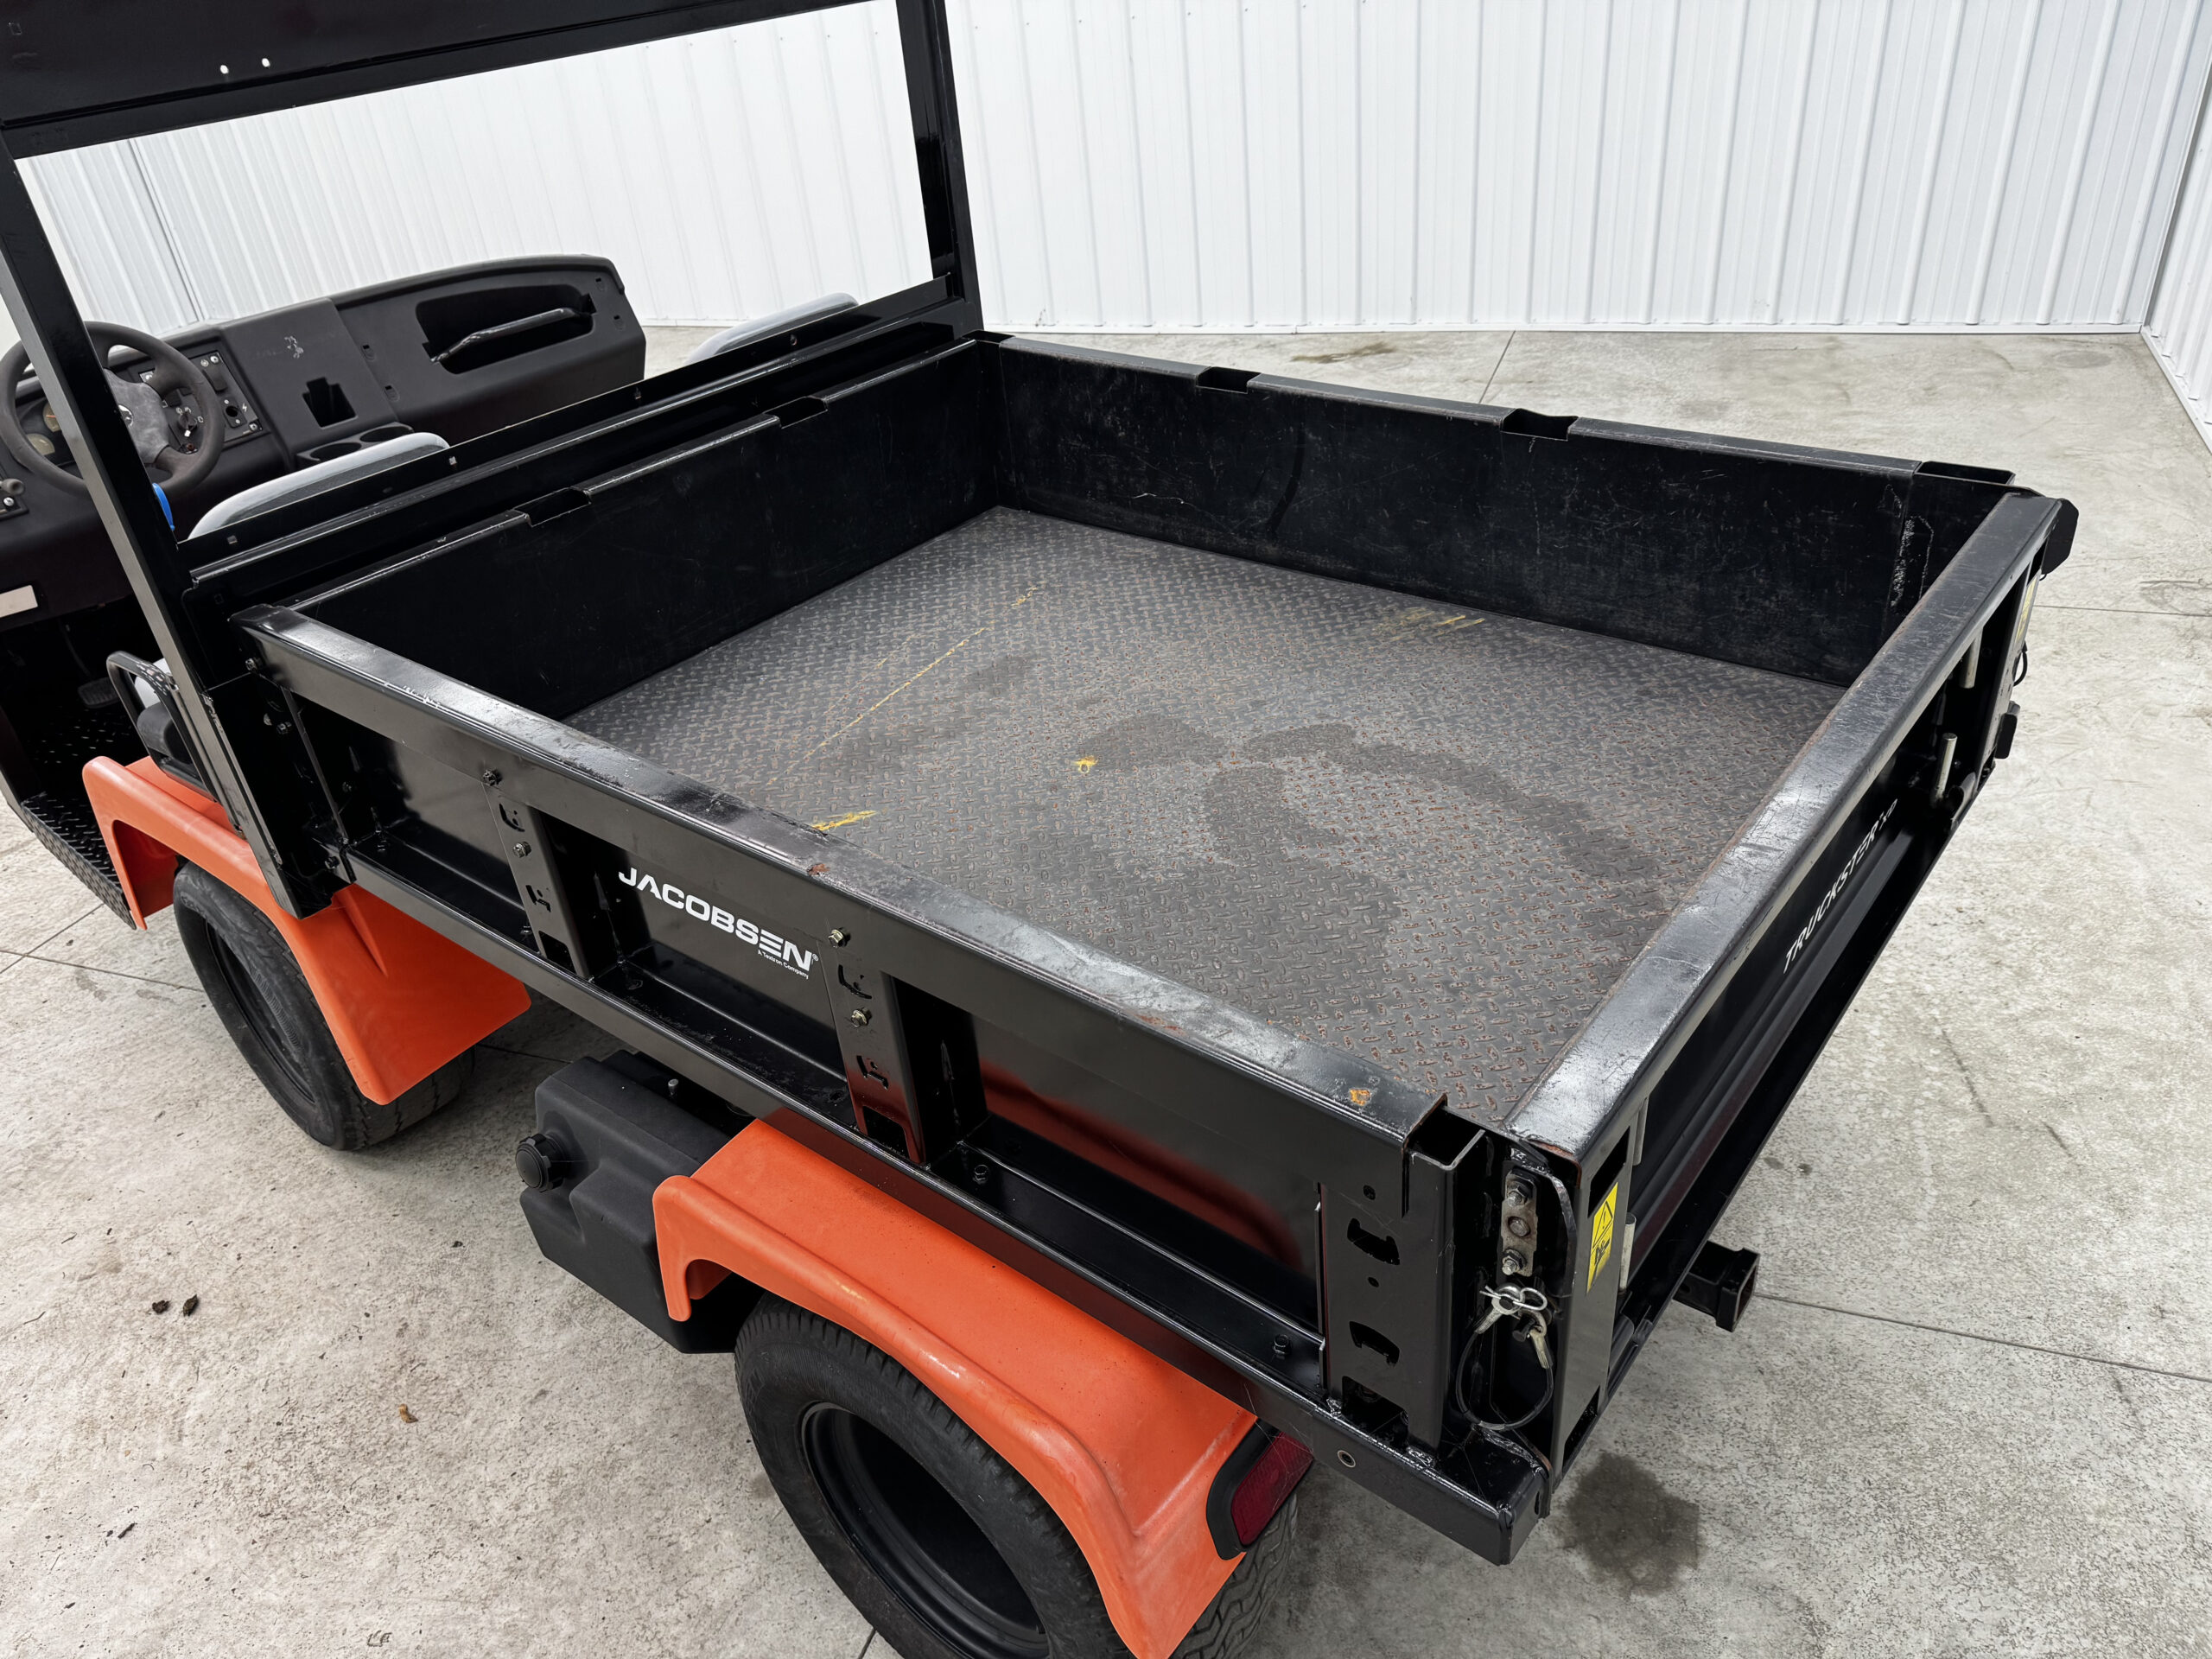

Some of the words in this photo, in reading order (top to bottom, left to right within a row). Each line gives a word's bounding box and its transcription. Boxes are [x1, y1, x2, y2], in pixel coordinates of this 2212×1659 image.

[618, 867, 813, 972] JACOBSEN
[1783, 820, 1879, 974] TRUCKSTER
[782, 962, 810, 980] Company
